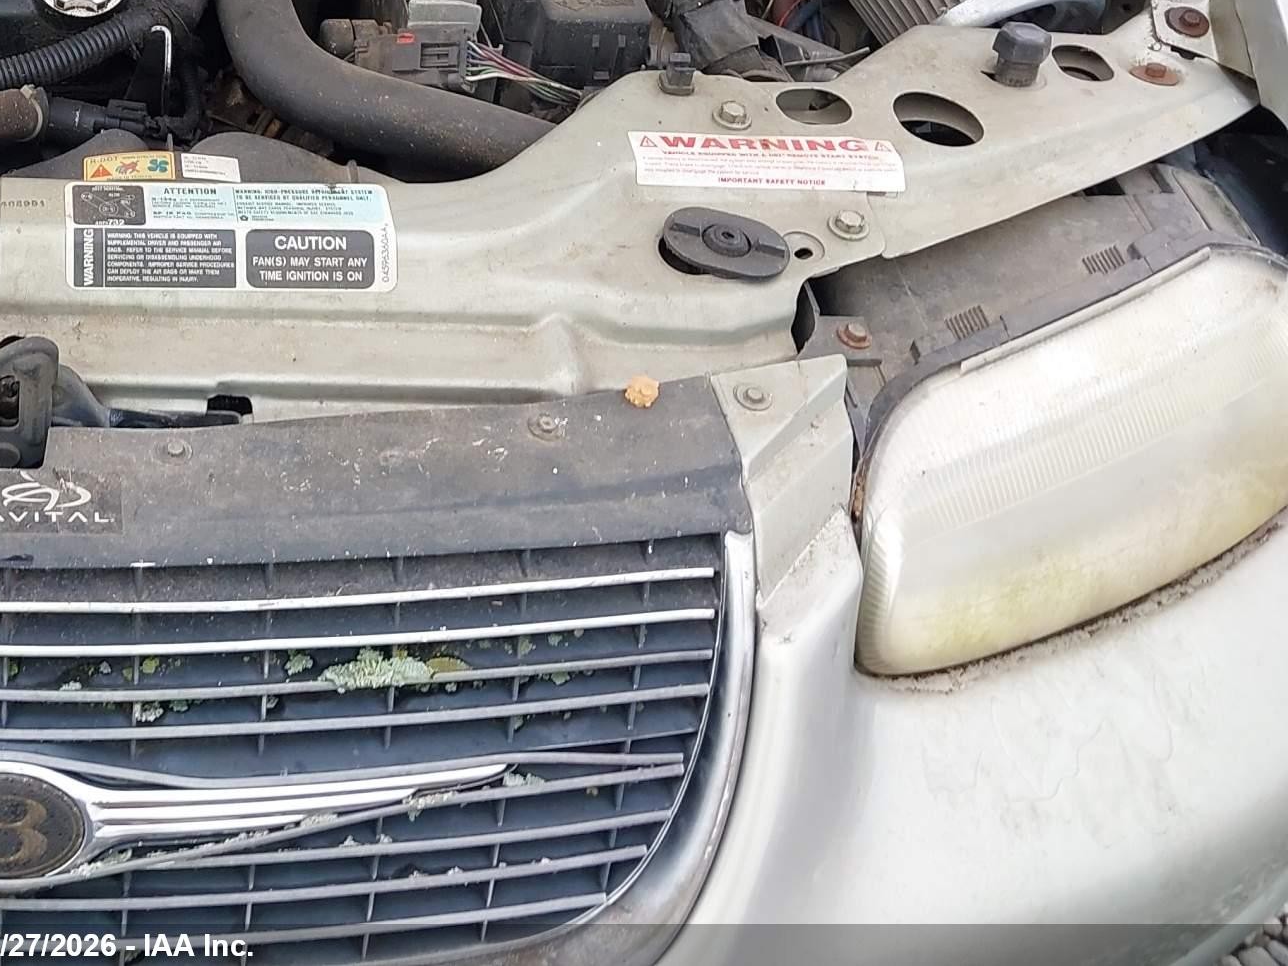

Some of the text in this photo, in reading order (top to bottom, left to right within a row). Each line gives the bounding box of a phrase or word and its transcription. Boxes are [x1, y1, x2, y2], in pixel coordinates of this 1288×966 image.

[660, 136, 869, 151] WARNING
[164, 187, 217, 195] ATTENTION
[274, 235, 347, 251] CAUTION
[83, 228, 95, 286] WARNING
[252, 256, 368, 267] FAN(S) MAY START ANY
[259, 270, 363, 282] TIME IGNITION IS ON
